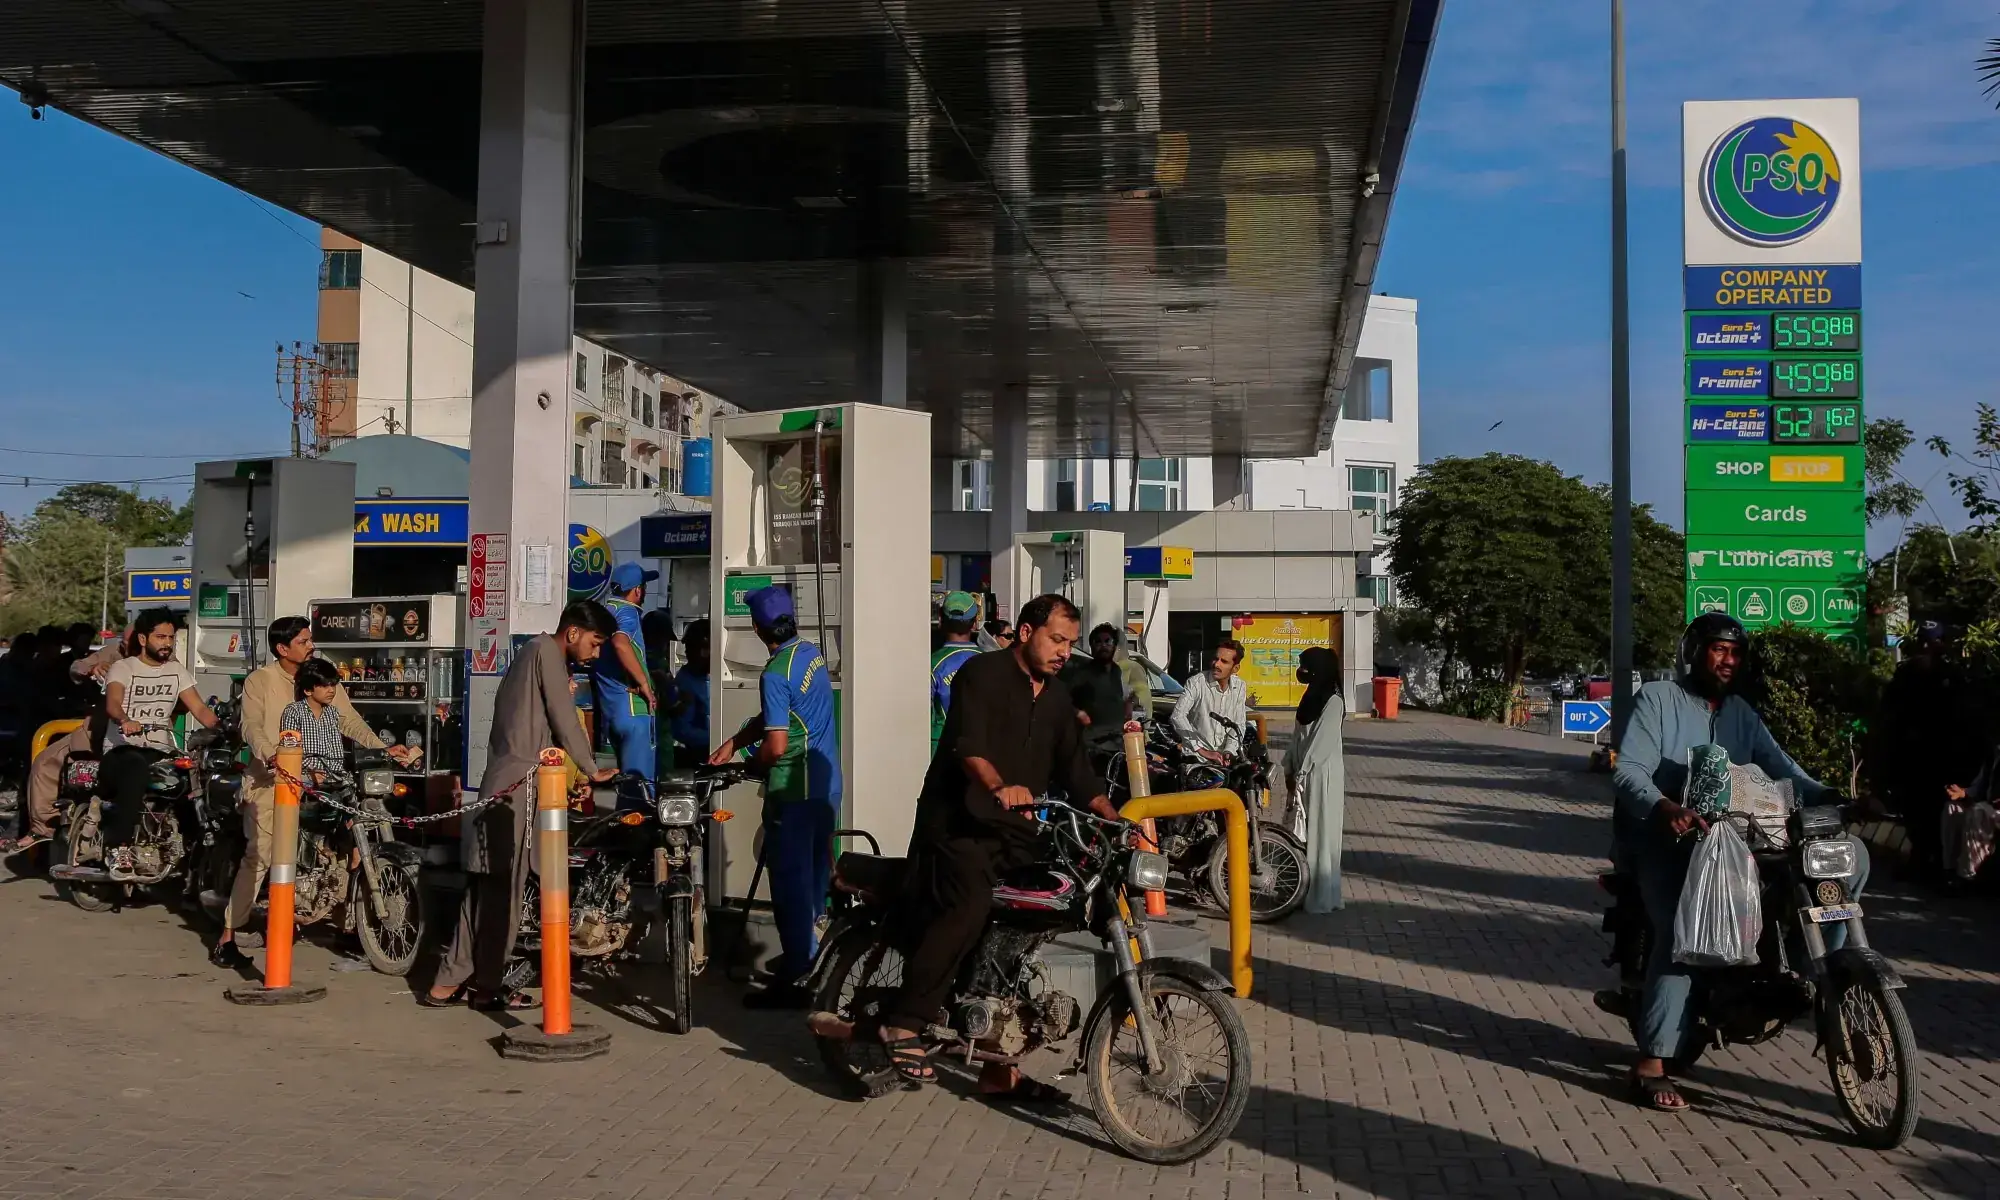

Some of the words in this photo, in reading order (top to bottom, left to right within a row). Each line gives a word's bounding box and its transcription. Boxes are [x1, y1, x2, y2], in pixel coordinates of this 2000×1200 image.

[1742, 152, 1824, 192] PSO
[1720, 270, 1828, 286] COMPANY
[1716, 288, 1832, 304] OPERATED
[1698, 377, 1761, 388] Premier
[1692, 419, 1766, 430] Hi-Cetane
[1716, 462, 1764, 475] SHOP
[1783, 462, 1830, 476] STOP
[1745, 504, 1807, 522] Cards
[382, 513, 439, 532] WASH
[1719, 550, 1833, 567] Lubricants
[152, 578, 176, 592] Tyre
[1828, 598, 1854, 610] ATM
[321, 616, 356, 628] CARIENT
[800, 667, 814, 694] HAPPY
[135, 685, 172, 696] BUZZ
[132, 708, 164, 718] ING
[1570, 713, 1587, 721] OUT
